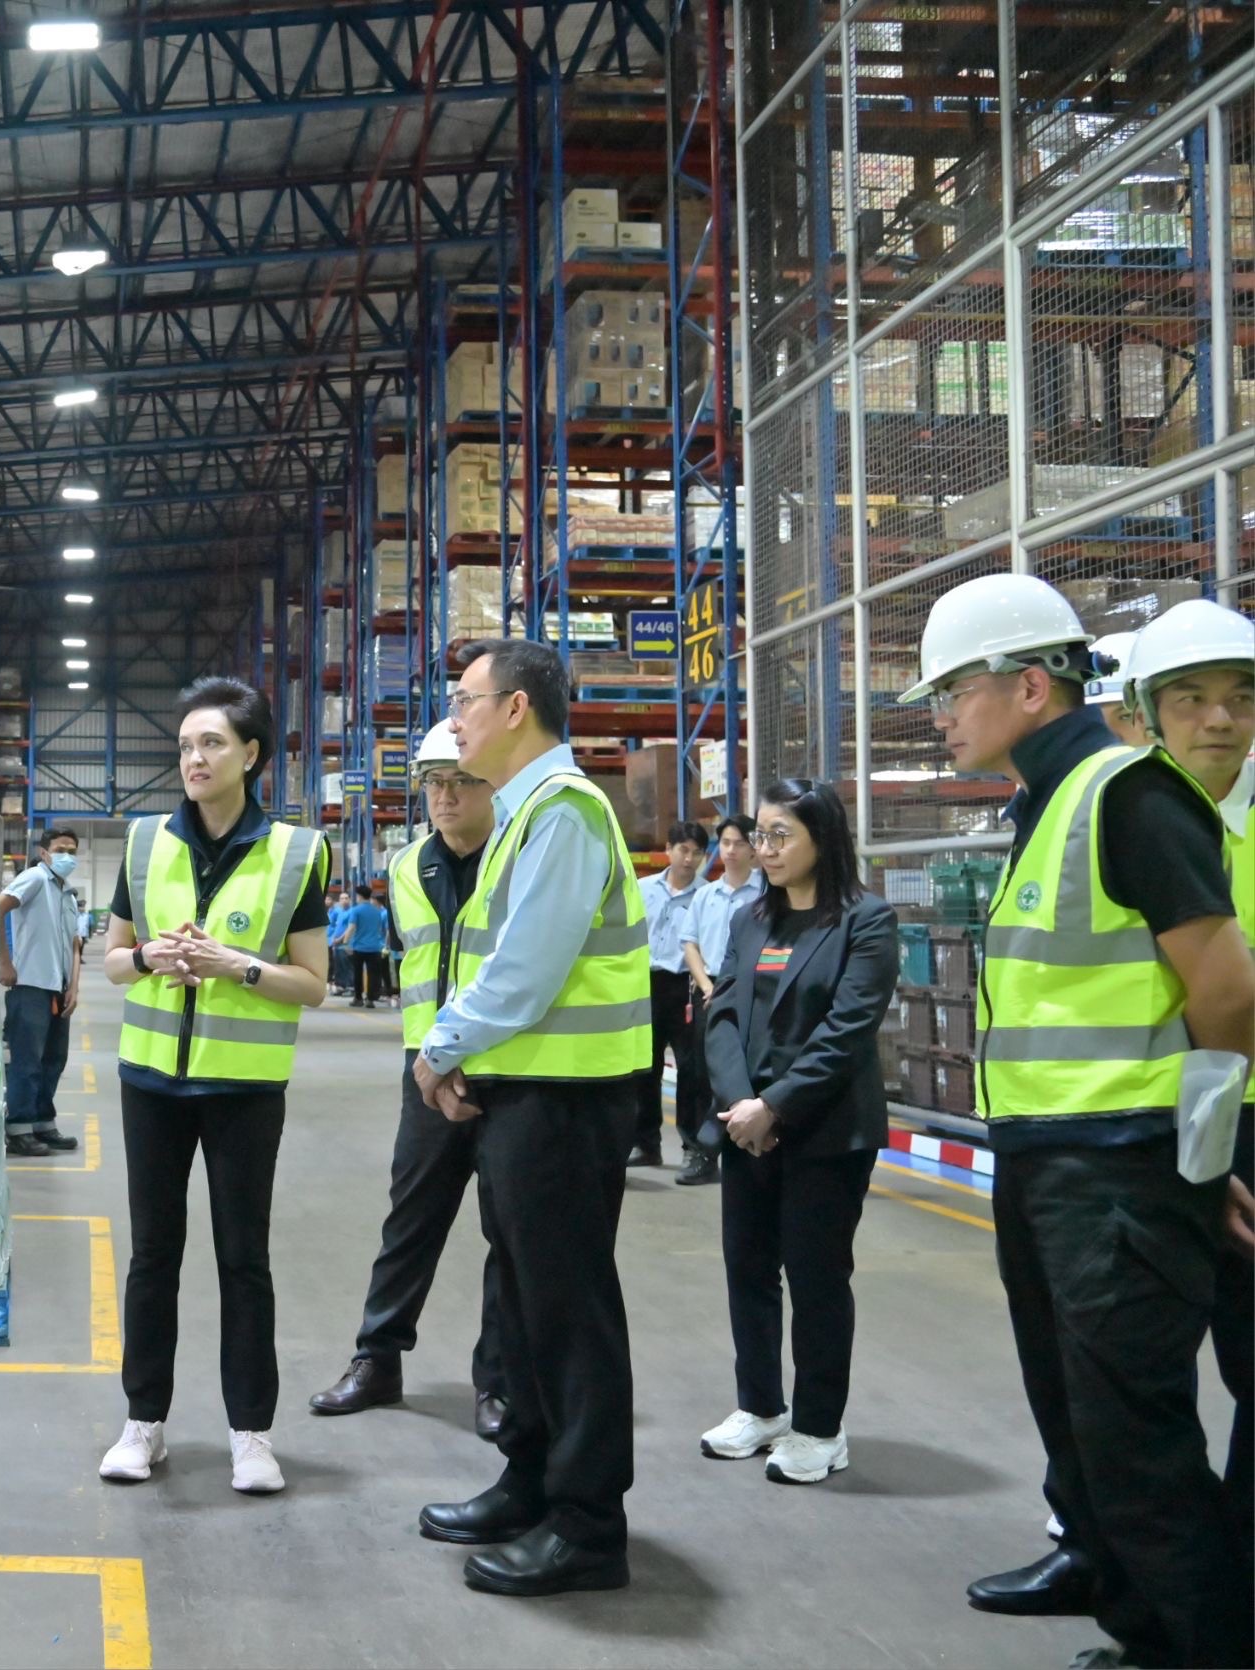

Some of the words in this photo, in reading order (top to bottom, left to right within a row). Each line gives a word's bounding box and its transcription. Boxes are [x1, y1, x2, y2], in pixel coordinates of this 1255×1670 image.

[635, 621, 675, 634] 44/46
[687, 584, 714, 632] 44
[688, 637, 715, 684] 46
